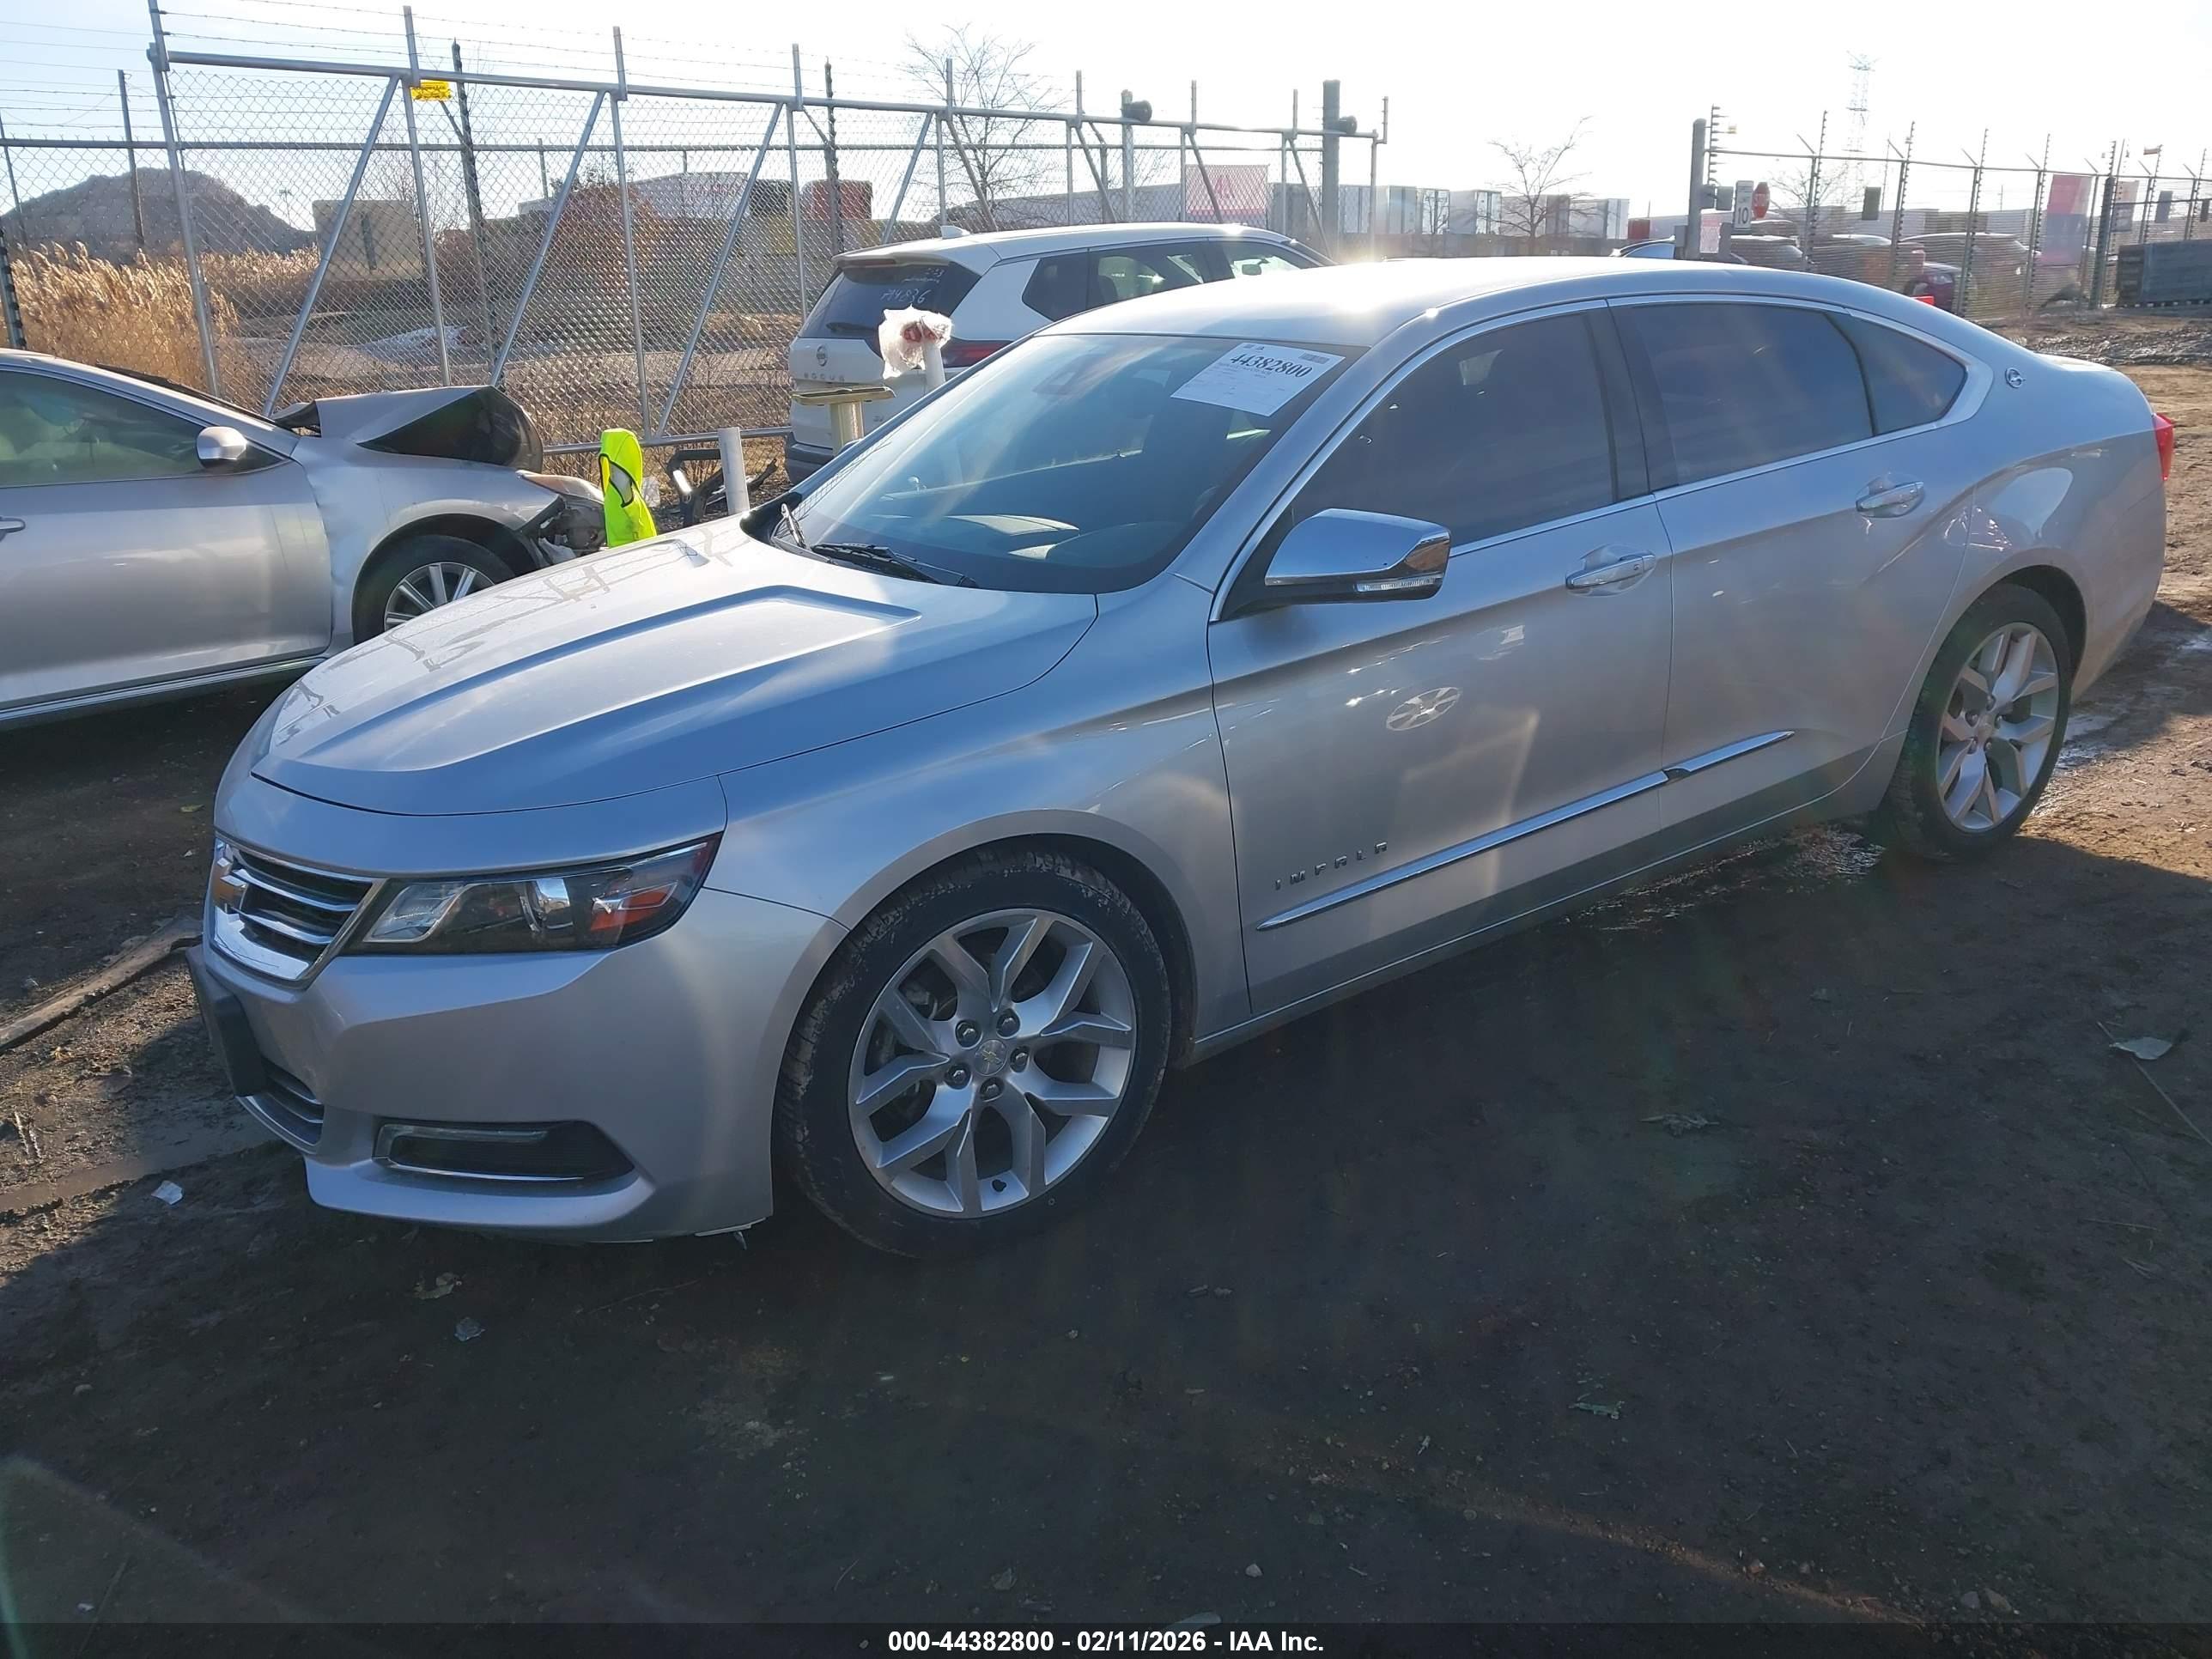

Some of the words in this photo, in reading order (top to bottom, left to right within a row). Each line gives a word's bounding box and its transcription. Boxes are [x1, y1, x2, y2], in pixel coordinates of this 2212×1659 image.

[1737, 207, 1749, 225] 10
[1230, 353, 1314, 378] 44382800
[1275, 842, 1388, 890] IMPALA
